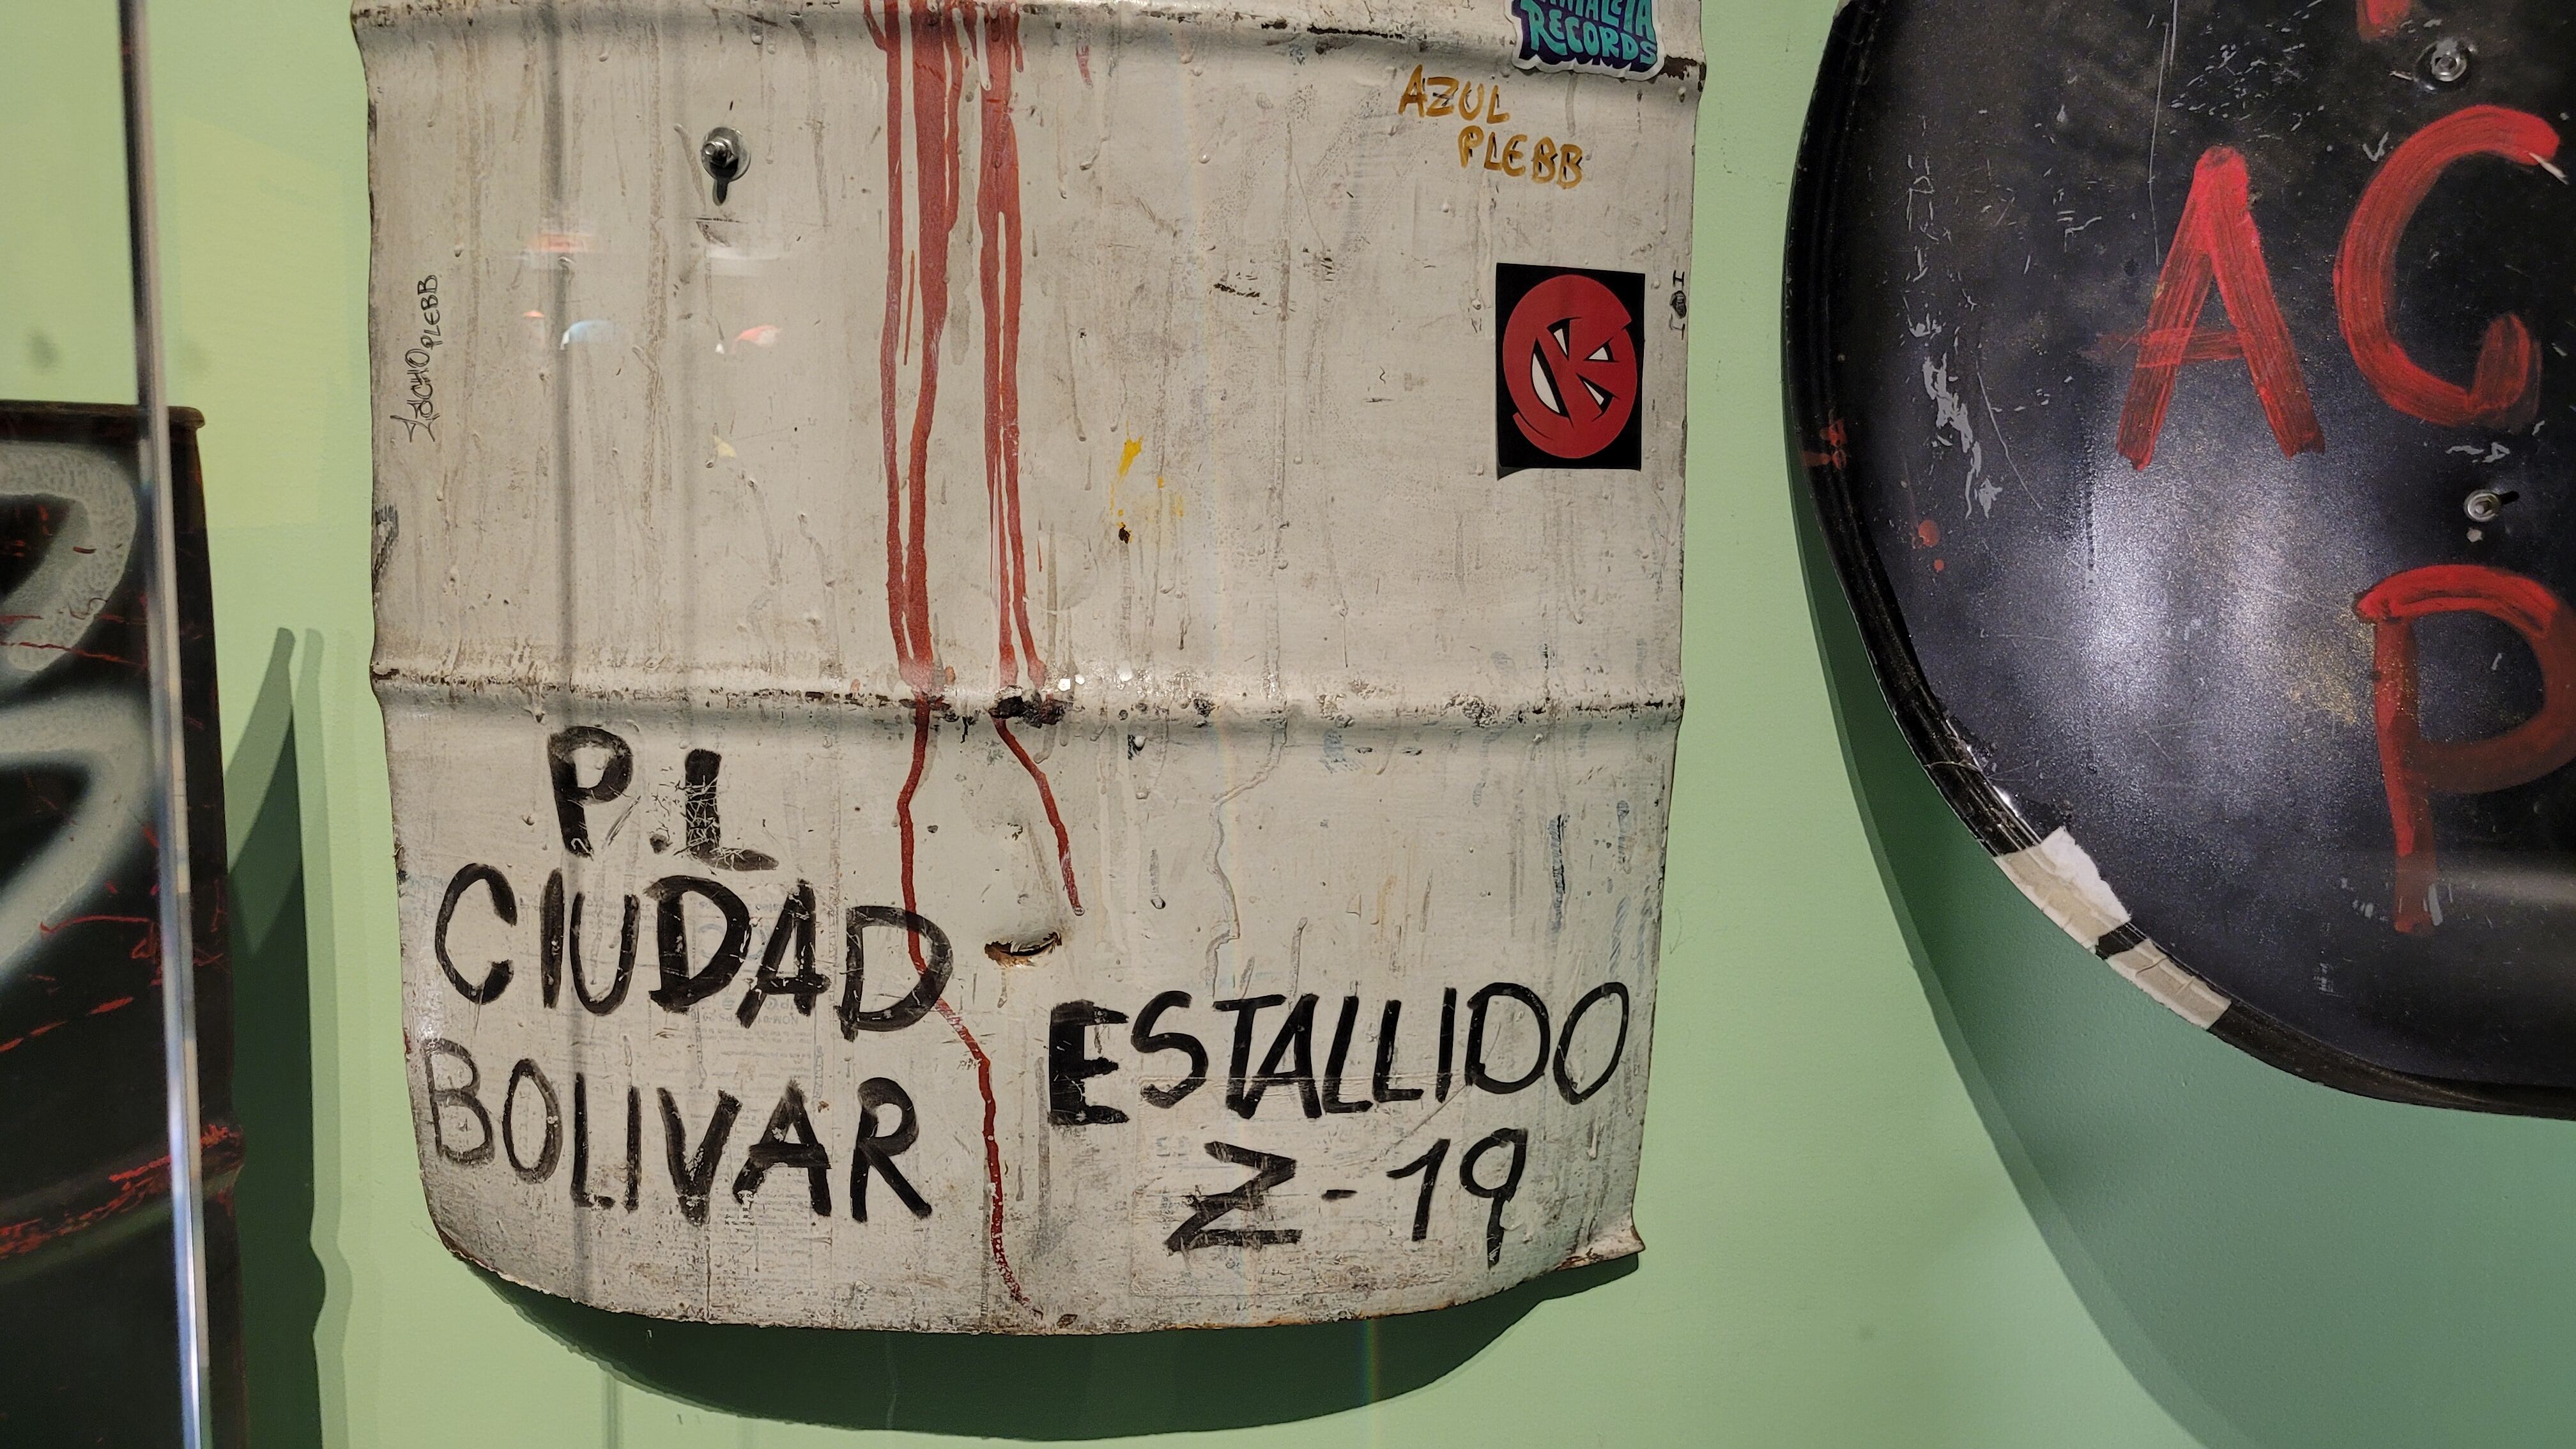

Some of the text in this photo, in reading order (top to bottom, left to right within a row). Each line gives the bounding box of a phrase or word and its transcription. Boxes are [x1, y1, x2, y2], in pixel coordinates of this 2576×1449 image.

[1520, 0, 1657, 65] RECORDS
[1398, 64, 1510, 125] AZUL
[1457, 125, 1584, 190] PLEBB
[435, 862, 954, 1041] CIUDAD
[1047, 981, 1630, 1126] ESTALLIDO
[422, 1037, 933, 1225] BOLIVAR
